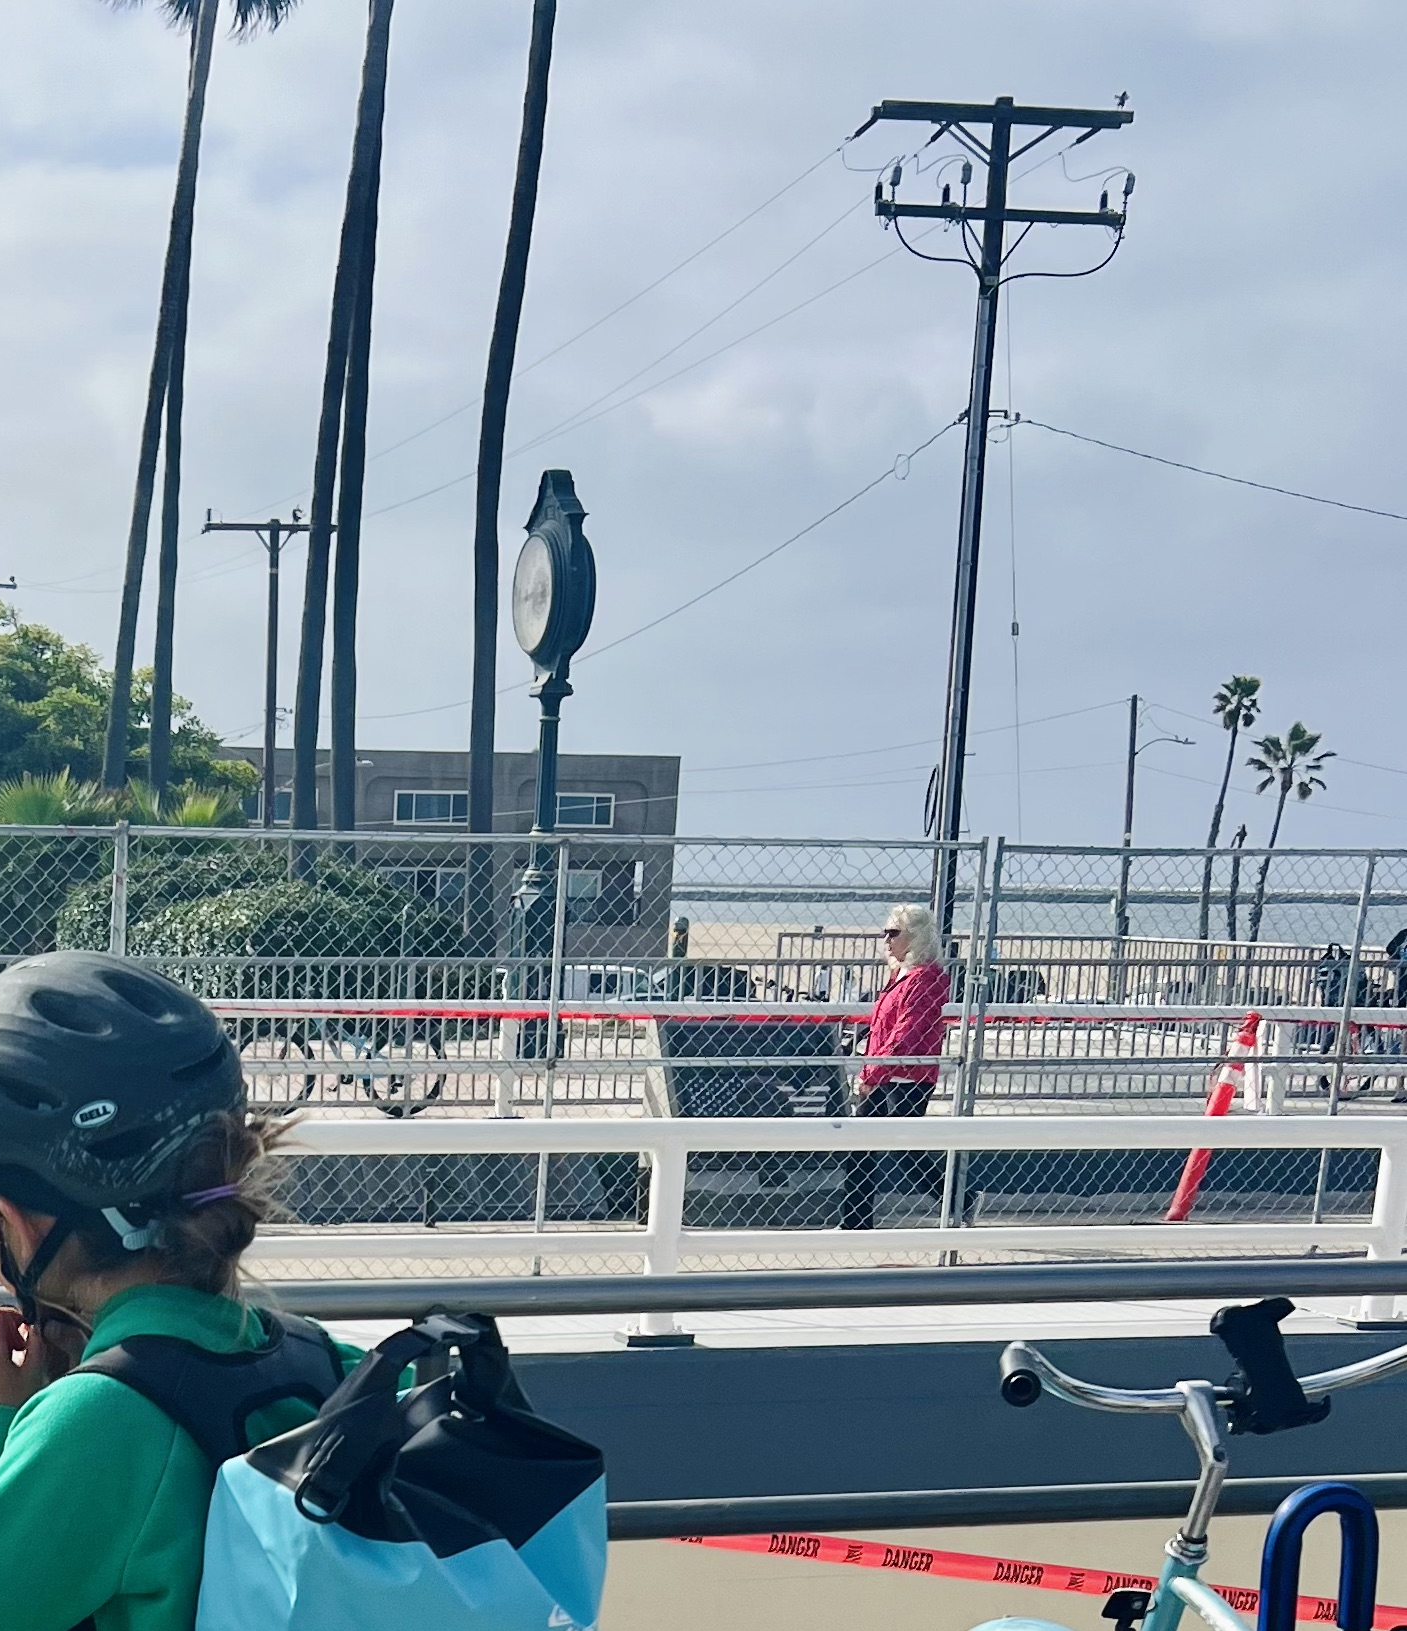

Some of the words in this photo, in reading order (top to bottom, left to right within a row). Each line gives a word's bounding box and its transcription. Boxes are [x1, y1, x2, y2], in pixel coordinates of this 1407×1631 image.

[79, 1105, 111, 1123] BELL
[768, 1534, 821, 1558] DANGER
[881, 1548, 934, 1572] DANGER
[993, 1562, 1045, 1586] DANGER
